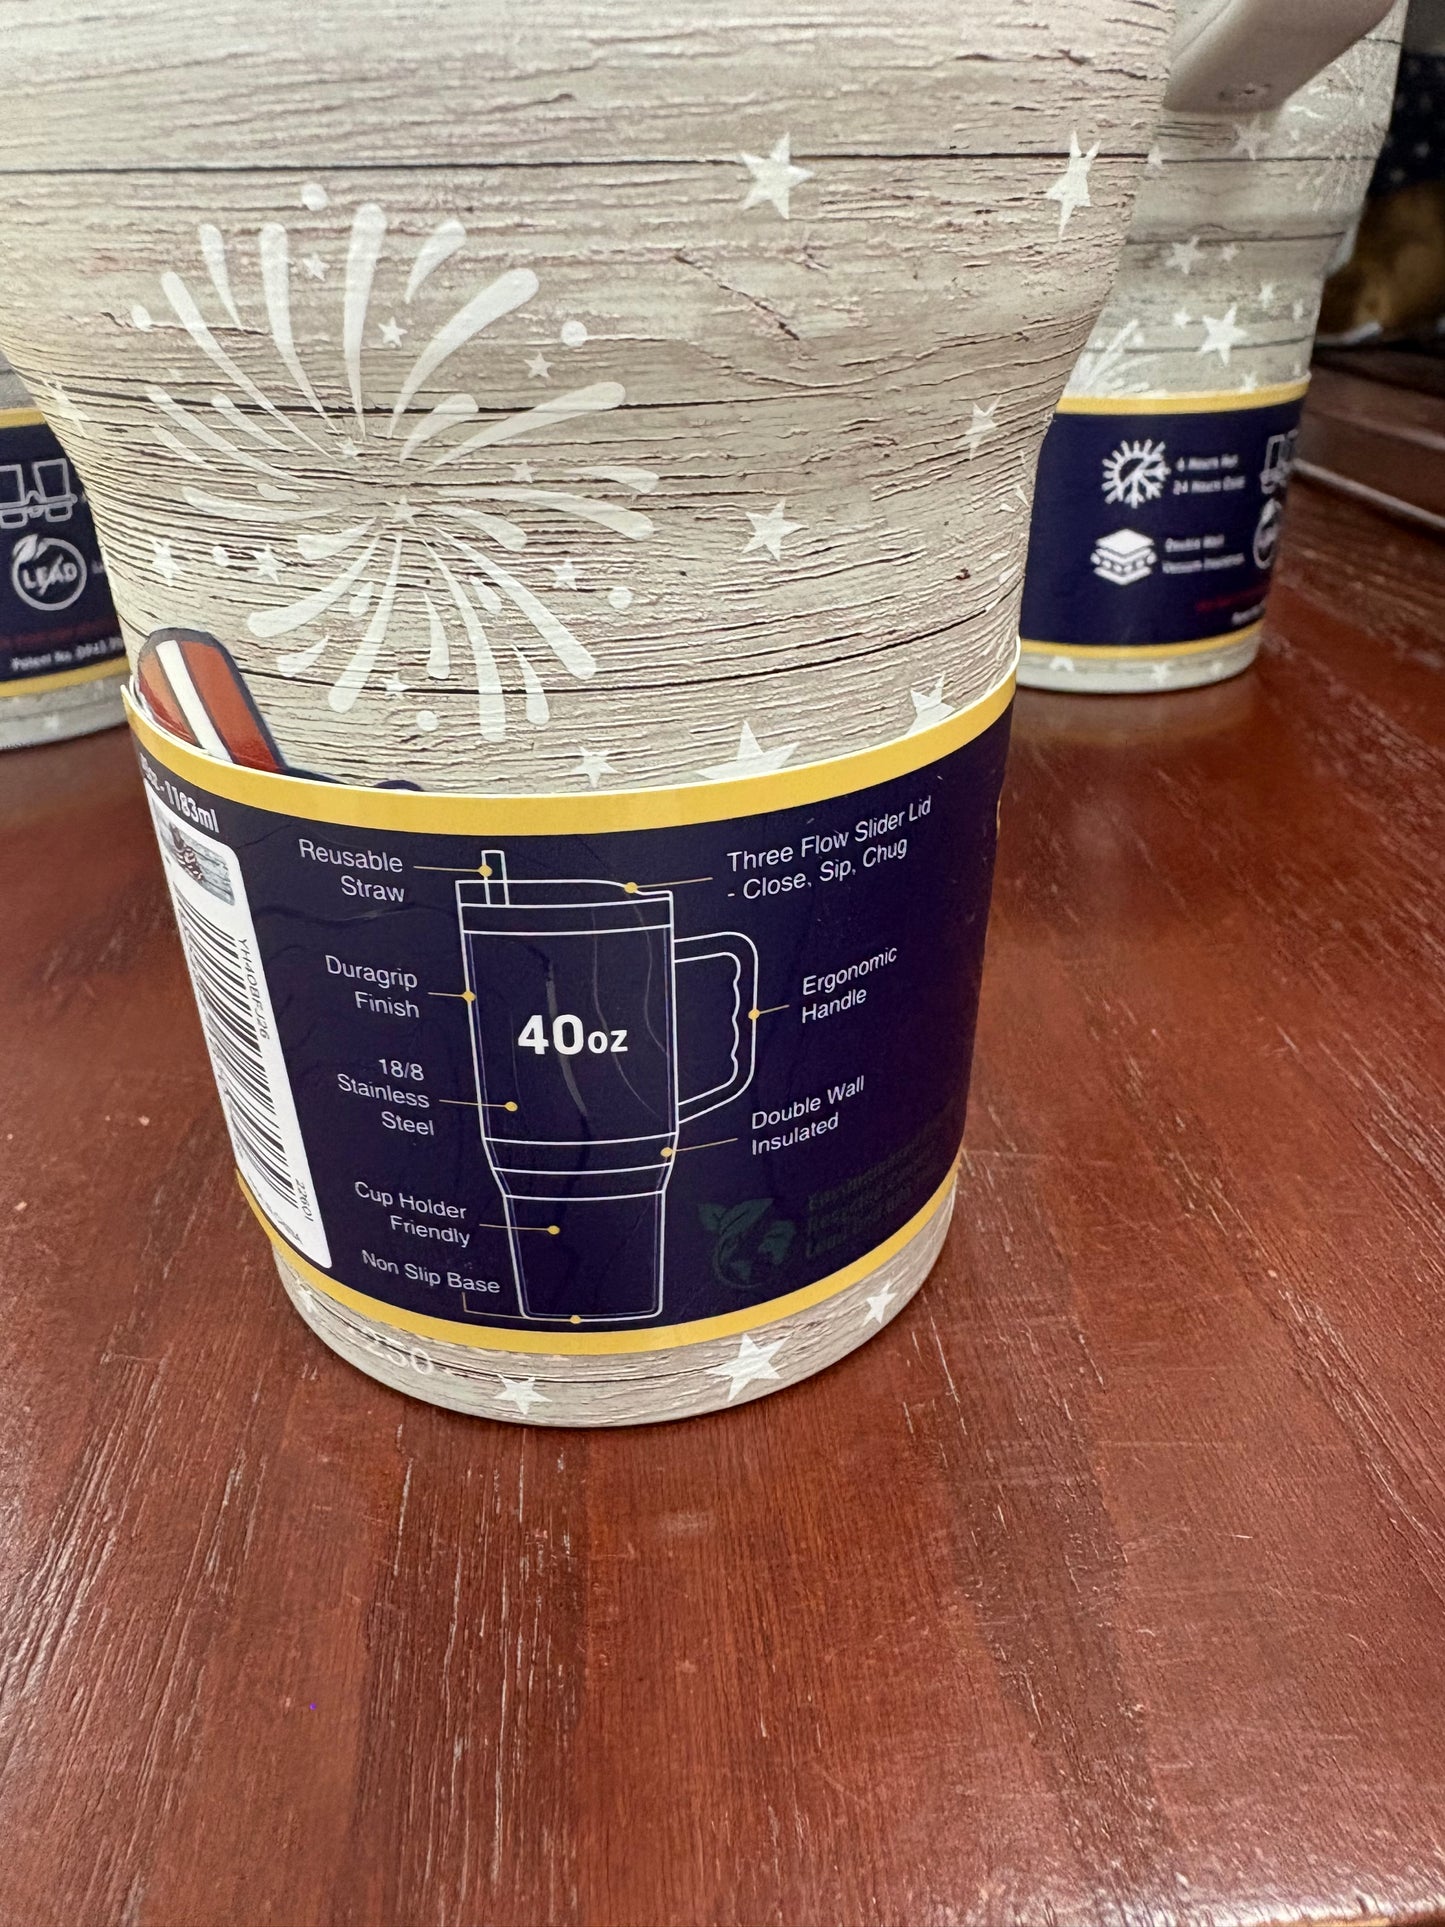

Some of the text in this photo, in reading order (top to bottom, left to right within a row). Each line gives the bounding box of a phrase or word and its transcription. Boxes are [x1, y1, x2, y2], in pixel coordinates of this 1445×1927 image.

[726, 795, 931, 872] Three Flow Slider Lid
[298, 838, 403, 873] Reusable
[862, 838, 908, 868] Chug
[340, 875, 405, 903] Straw
[325, 954, 418, 990] Duragrip
[802, 947, 897, 996] Ergonomic
[354, 990, 420, 1018] Finish
[802, 987, 867, 1024] Handle
[378, 1058, 425, 1081] 18/8
[337, 1073, 430, 1109] Stainless
[751, 1075, 864, 1130] Double Wall
[381, 1105, 434, 1136] Steel
[751, 1112, 839, 1155] Insulated
[354, 1181, 467, 1219] Cup Holder
[390, 1215, 470, 1248] Friendly
[361, 1249, 500, 1293] Non Slip Base
